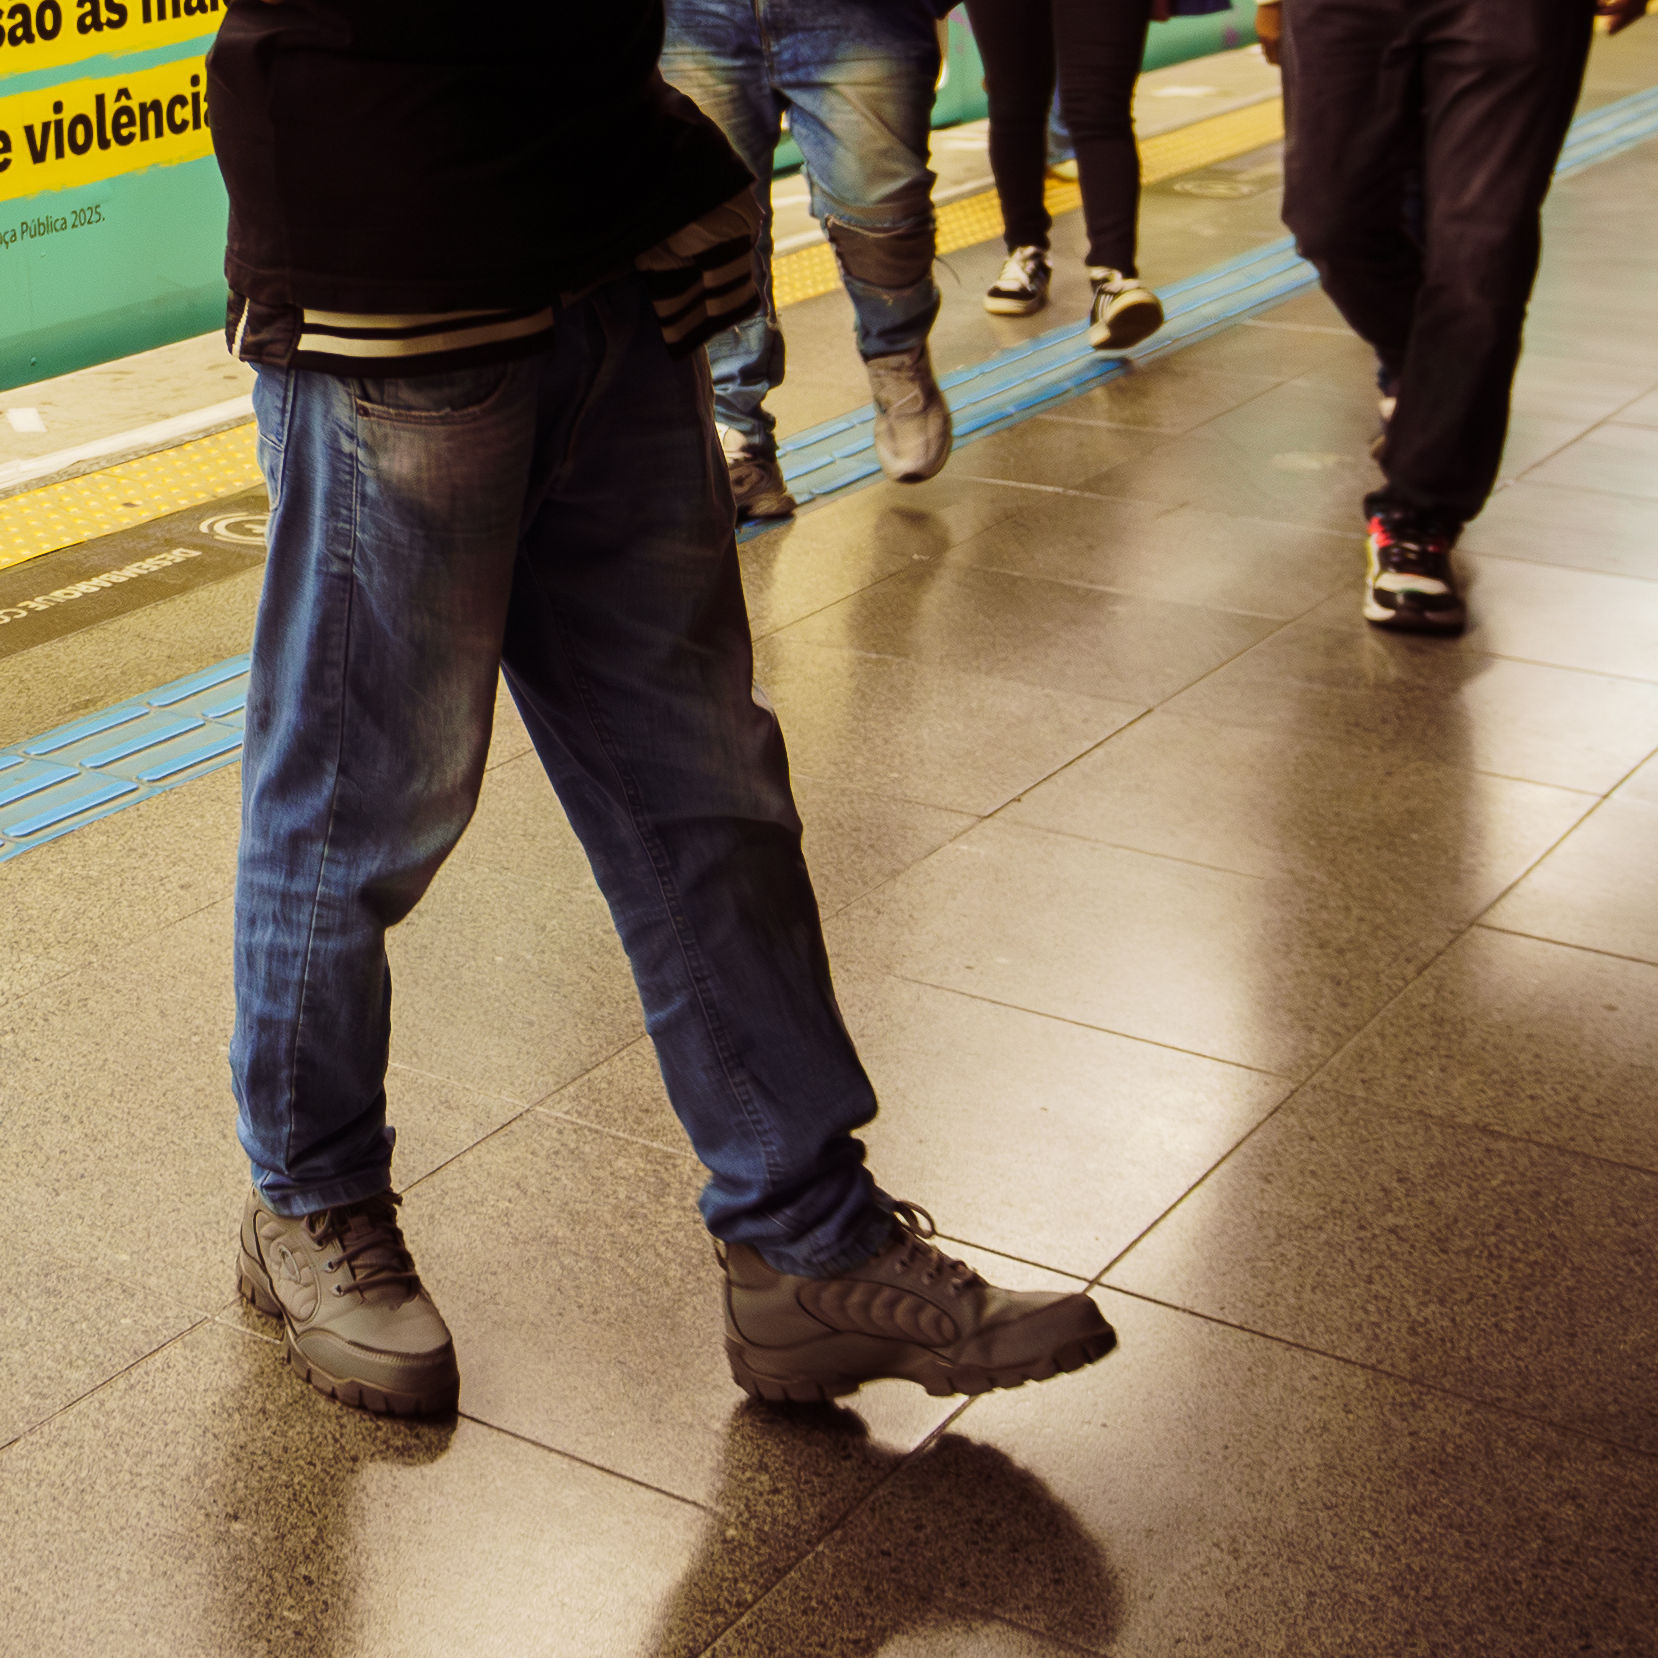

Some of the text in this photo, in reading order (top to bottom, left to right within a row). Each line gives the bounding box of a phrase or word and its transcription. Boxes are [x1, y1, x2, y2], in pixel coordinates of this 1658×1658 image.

[20, 215, 67, 241] Pública
[71, 204, 105, 229] 2025.
[25, 547, 203, 612] DESEMBARQUE
